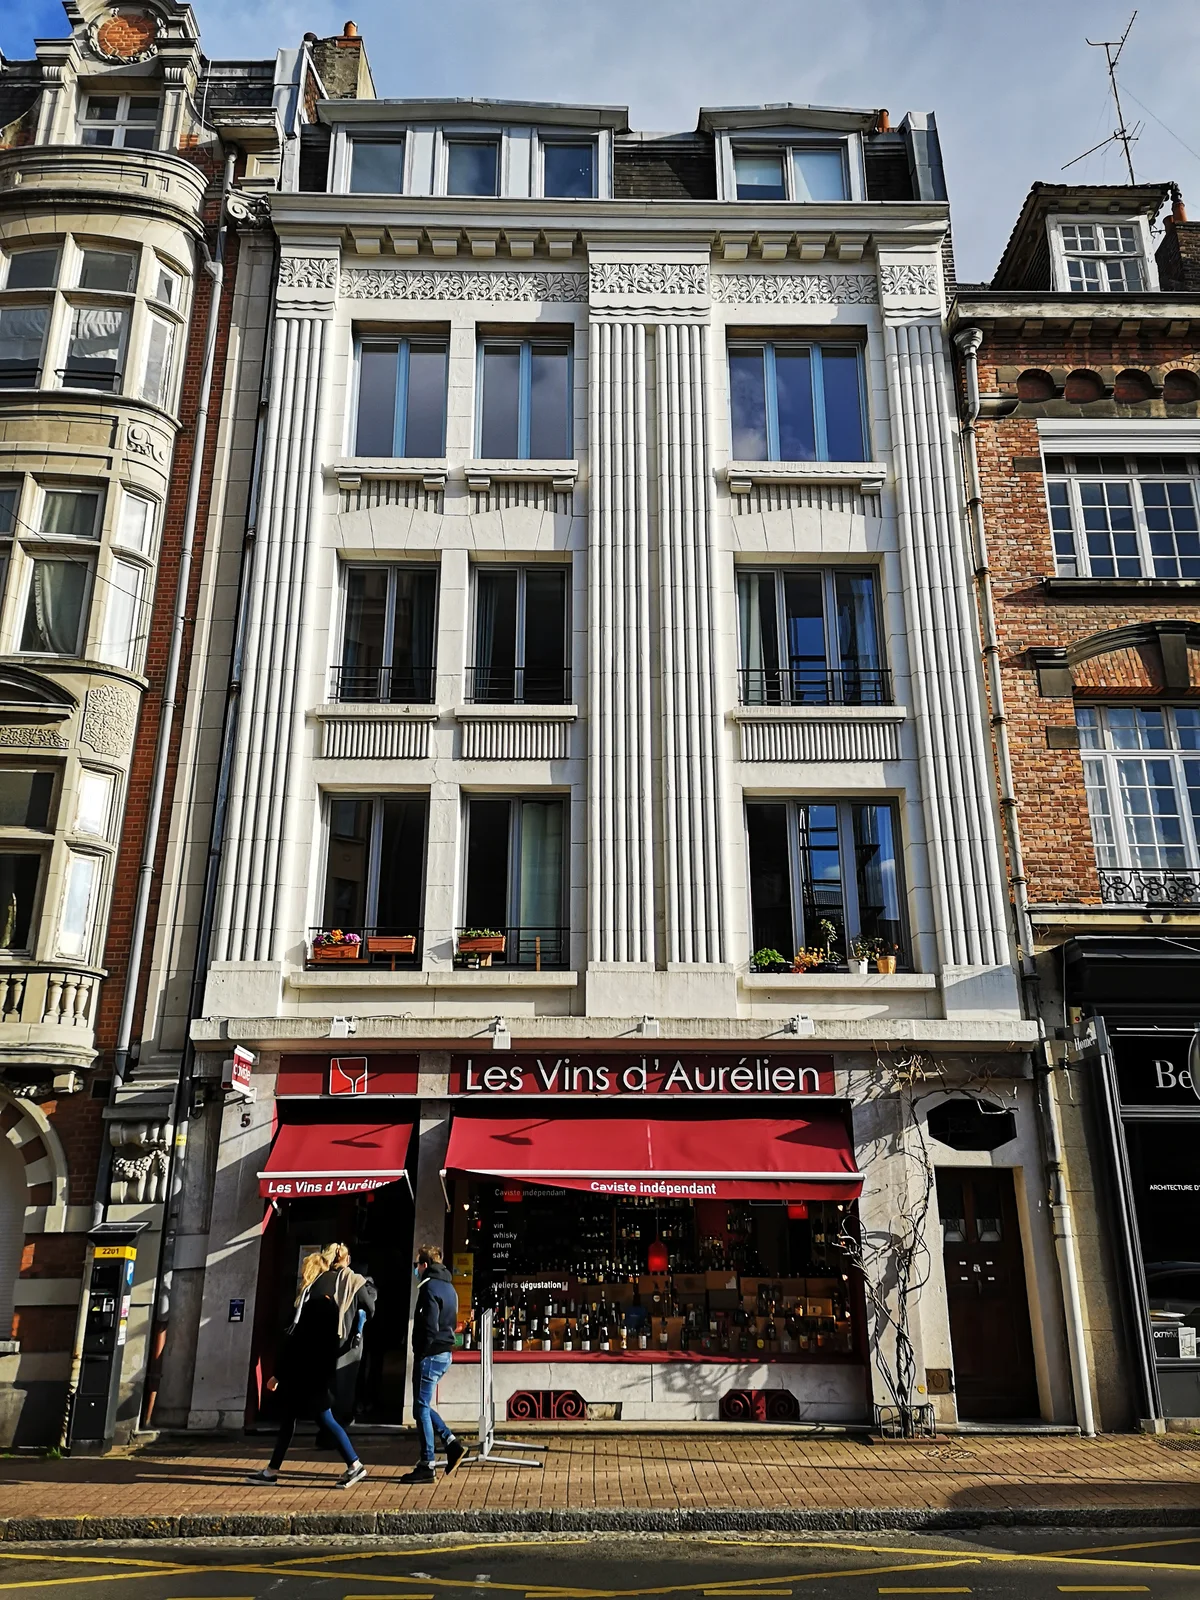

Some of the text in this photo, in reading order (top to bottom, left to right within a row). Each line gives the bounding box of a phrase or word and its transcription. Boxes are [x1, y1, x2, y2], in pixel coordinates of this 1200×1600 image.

[466, 1057, 820, 1092] Les Vins d'Aurélien
[1152, 1059, 1193, 1089] Be
[240, 1113, 251, 1128] 5
[268, 1181, 292, 1194] Les
[296, 1180, 322, 1193] Vins
[494, 1188, 566, 1197] Caviste indépendant
[590, 1180, 717, 1196] Caviste indépendant
[492, 1231, 518, 1241] whisky
[102, 1247, 120, 1255] 2201
[492, 1241, 512, 1249] rhum
[492, 1250, 510, 1259] saké
[126, 1260, 135, 1281] P
[520, 1280, 562, 1290] dégustation
